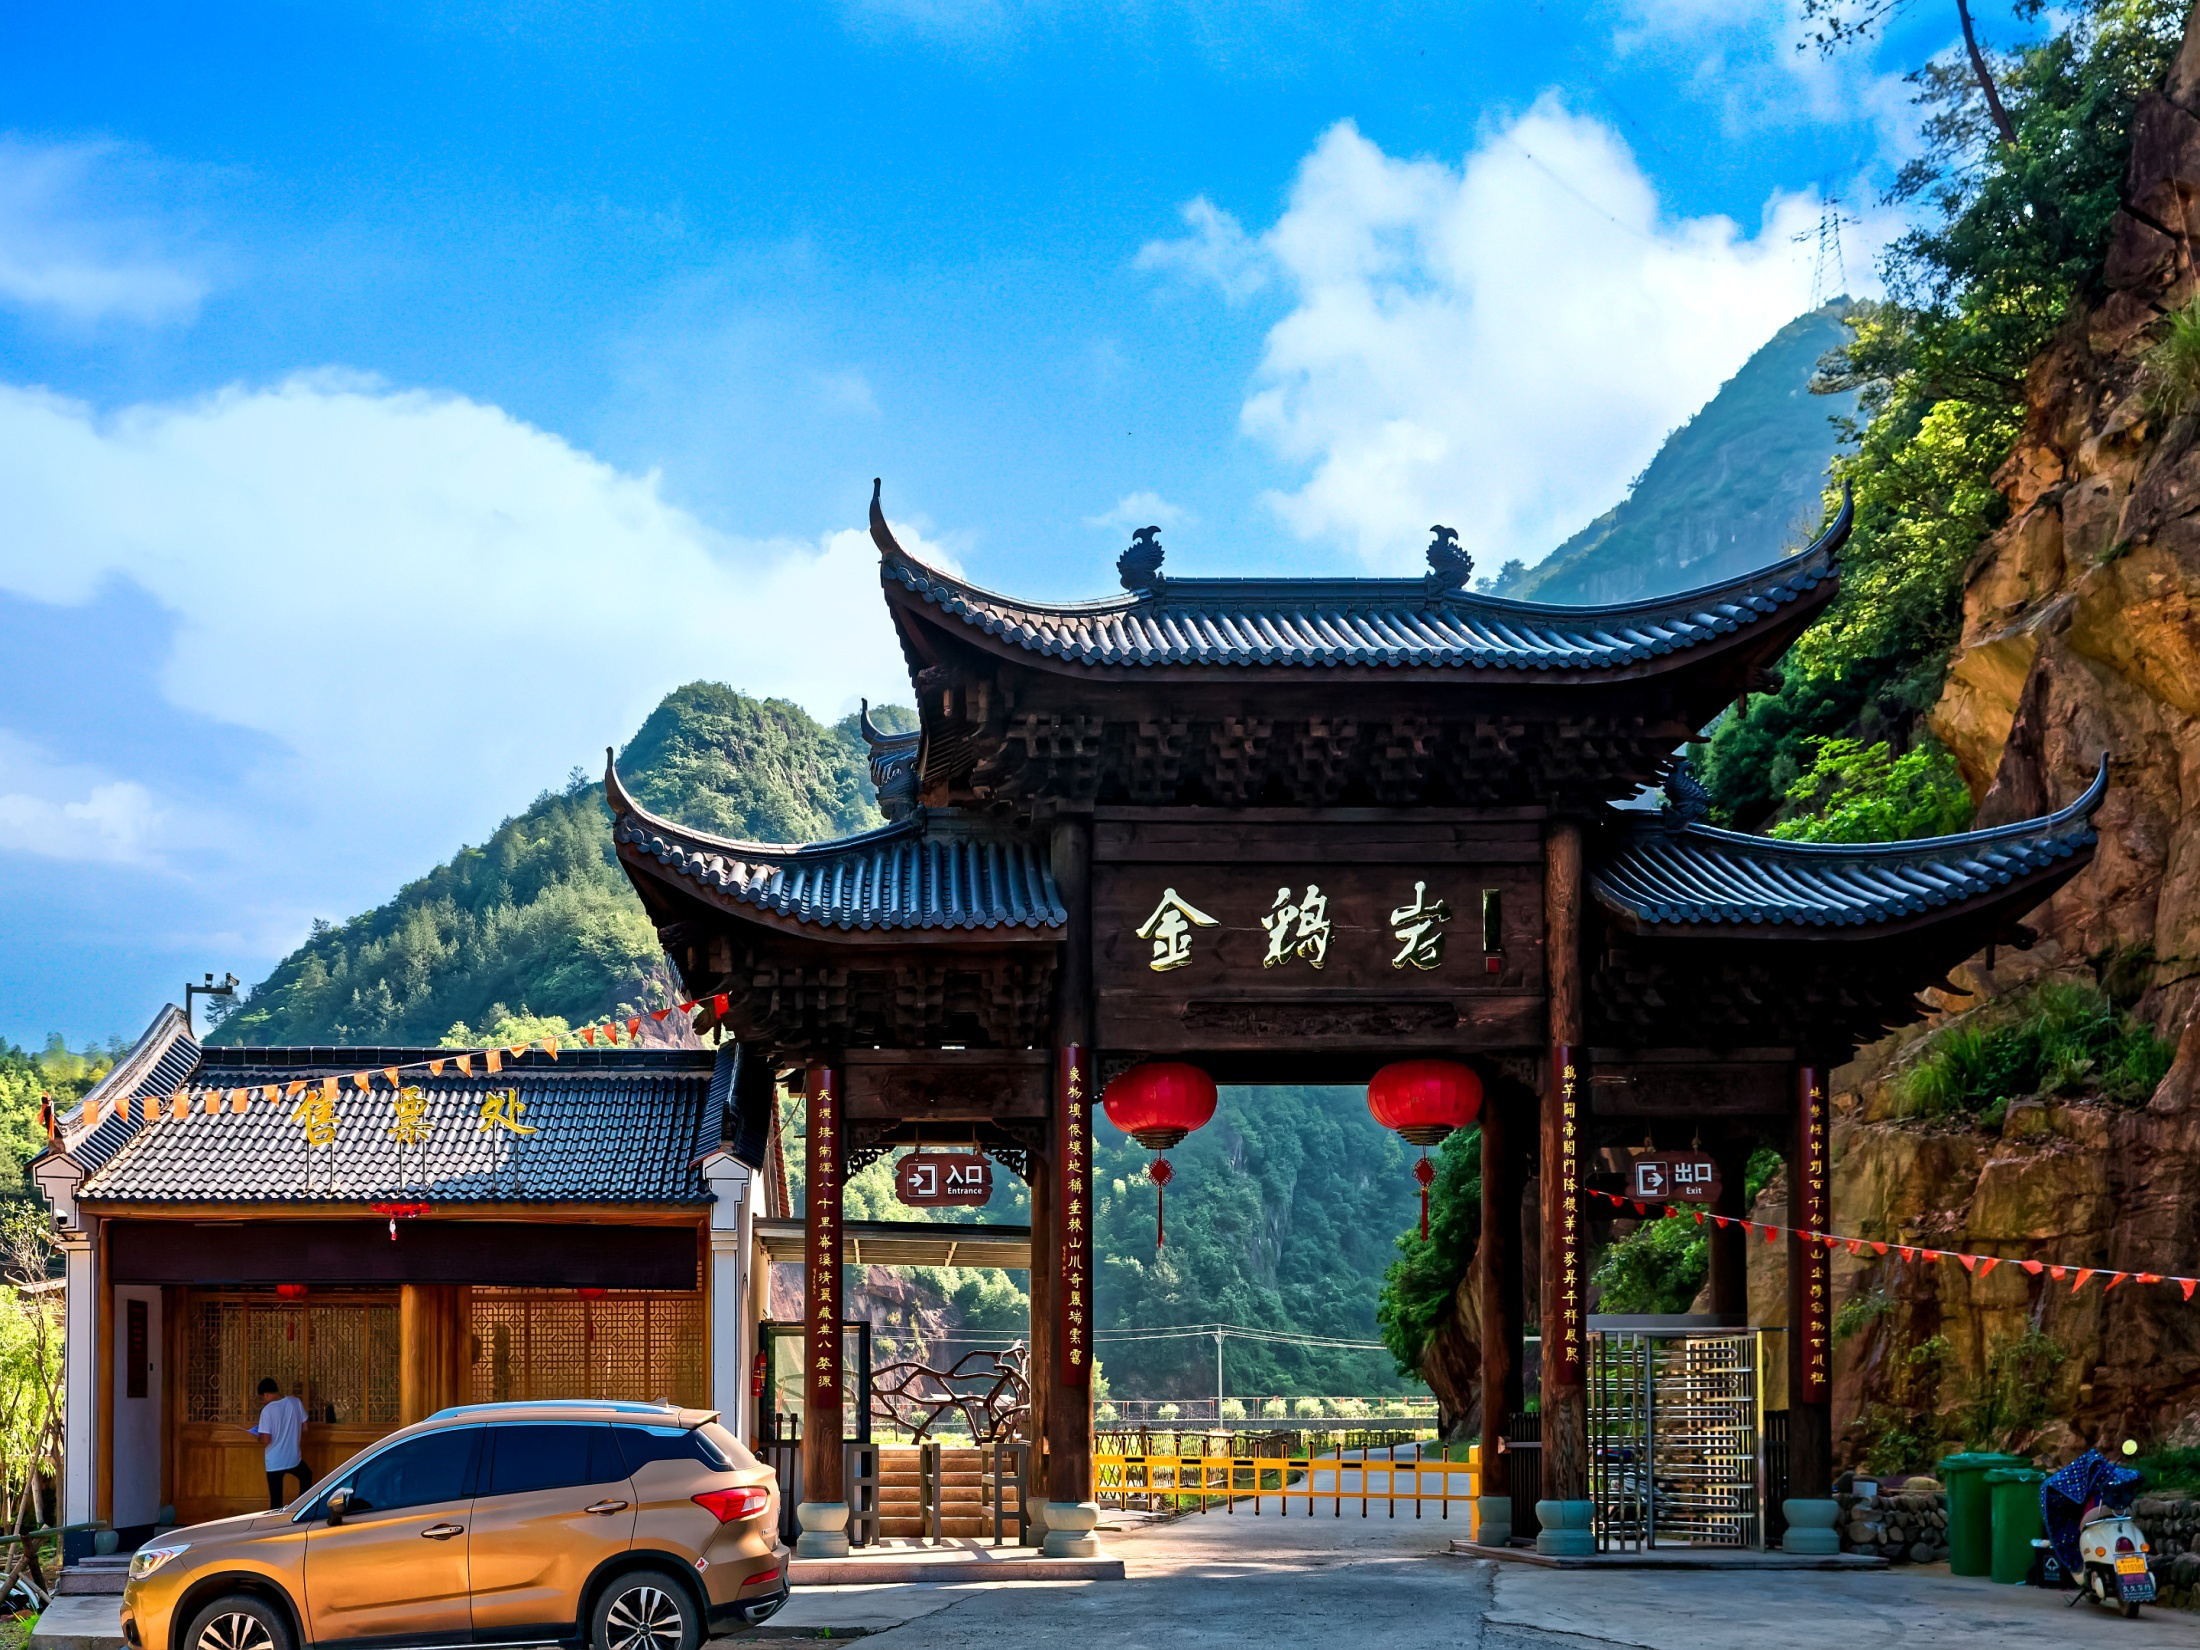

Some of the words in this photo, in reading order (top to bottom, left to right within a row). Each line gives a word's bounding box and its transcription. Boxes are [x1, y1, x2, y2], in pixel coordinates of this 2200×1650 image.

[292, 1086, 537, 1146] 售票处
[945, 1164, 982, 1184] 入口
[1675, 1162, 1712, 1183] 出口
[947, 1187, 982, 1195] Entrance
[1686, 1186, 1702, 1194] Exit
